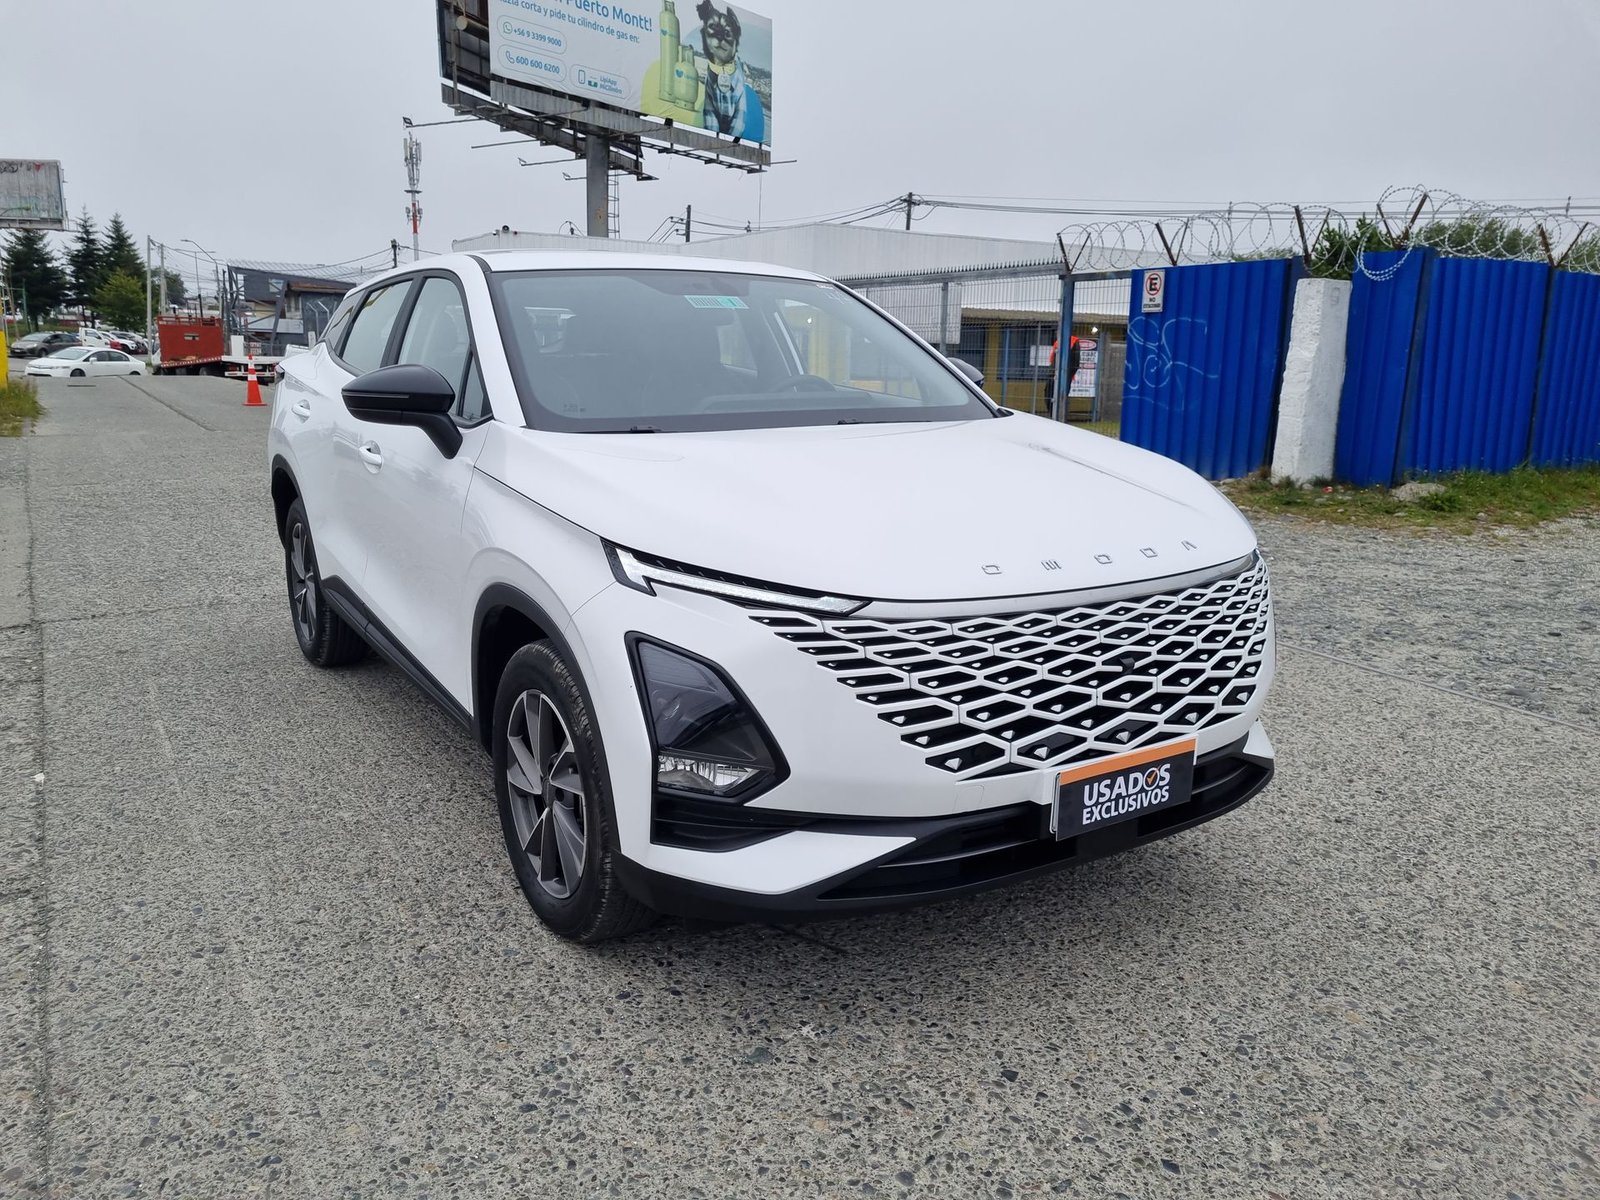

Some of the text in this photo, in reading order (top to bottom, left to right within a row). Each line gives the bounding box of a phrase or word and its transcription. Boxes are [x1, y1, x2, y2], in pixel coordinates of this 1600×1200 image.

[521, 1, 542, 13] corta
[543, 8, 549, 16] y
[549, 8, 567, 21] pide
[568, 15, 576, 24] tu
[577, 17, 605, 33] cilindro
[606, 26, 615, 36] de
[616, 31, 629, 40] gas
[629, 34, 640, 43] en:
[612, 6, 653, 32] Montt!
[513, 28, 526, 37] +56
[531, 32, 547, 42] 3399
[547, 36, 562, 47] 9000
[516, 56, 560, 74] 600 600 6200
[1149, 277, 1160, 292] E
[1083, 763, 1171, 807] USADOS
[1082, 785, 1170, 826] EXCLUSIVOS
